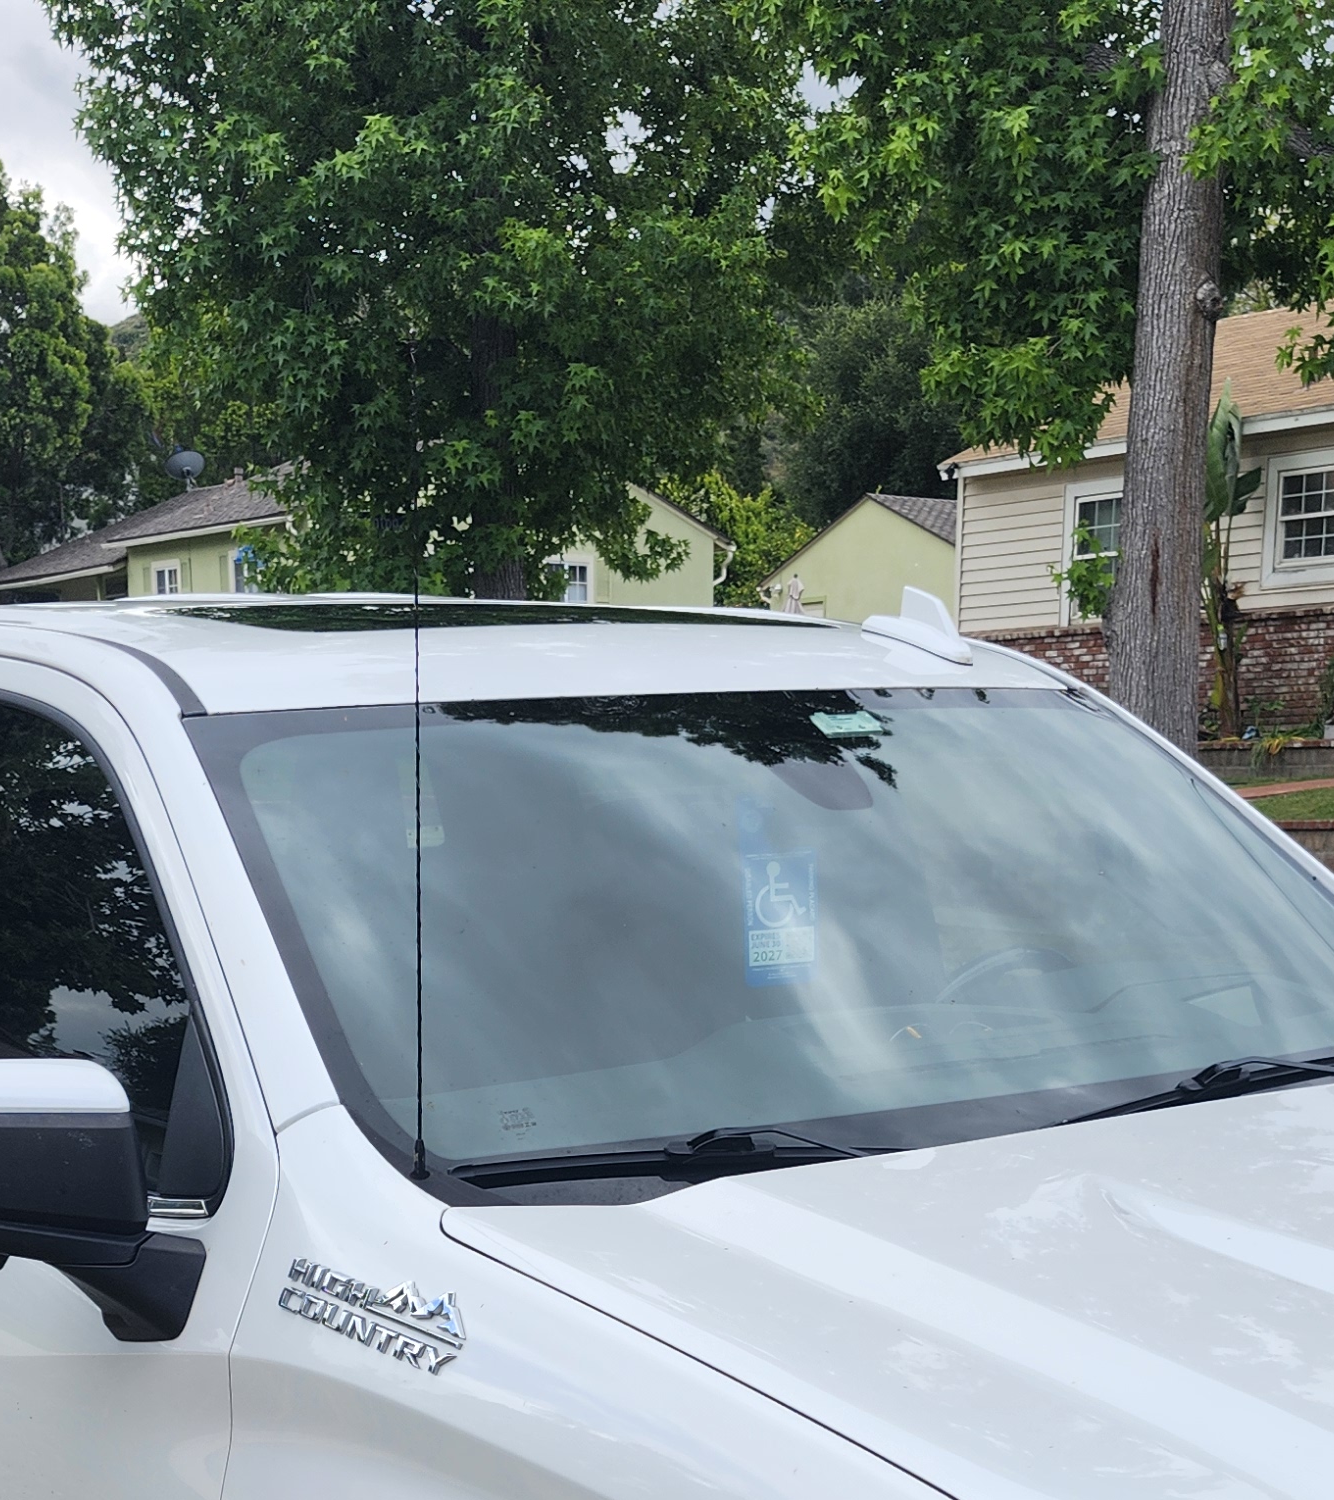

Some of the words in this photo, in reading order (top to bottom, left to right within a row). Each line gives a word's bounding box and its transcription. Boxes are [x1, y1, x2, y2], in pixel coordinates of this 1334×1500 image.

[751, 932, 781, 941] EXPIRES
[751, 941, 770, 949] JUNE
[753, 950, 783, 962] 2027
[288, 1257, 379, 1310] HIGH
[278, 1286, 457, 1376] COUNTRY
